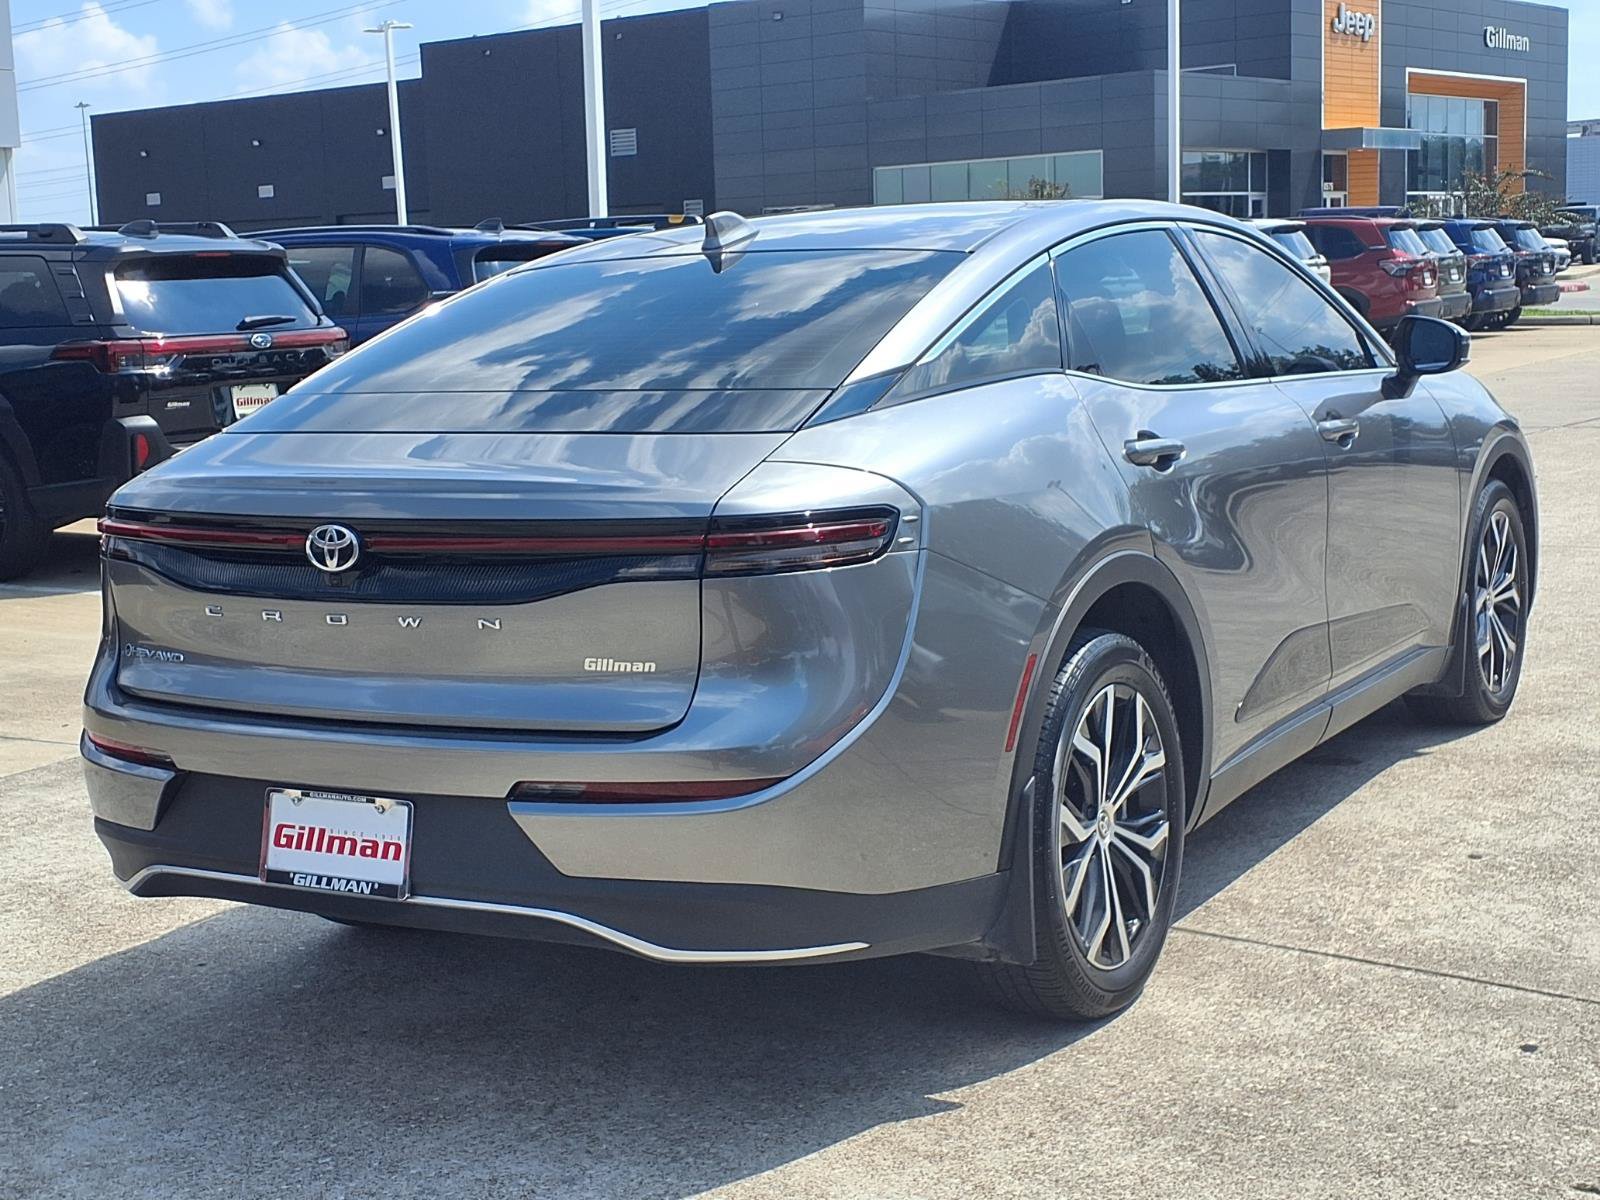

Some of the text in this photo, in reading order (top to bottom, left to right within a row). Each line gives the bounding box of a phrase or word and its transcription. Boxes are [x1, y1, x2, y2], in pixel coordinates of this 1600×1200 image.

[1332, 2, 1375, 42] Jeep
[1484, 26, 1529, 52] Gillman
[236, 397, 274, 406] Gillma
[204, 604, 501, 631] CROWN
[584, 657, 656, 672] Gillman
[309, 791, 367, 803] GILLMANAUTO.COM
[273, 823, 402, 861] Gillman
[293, 873, 372, 895] GILLMAN
